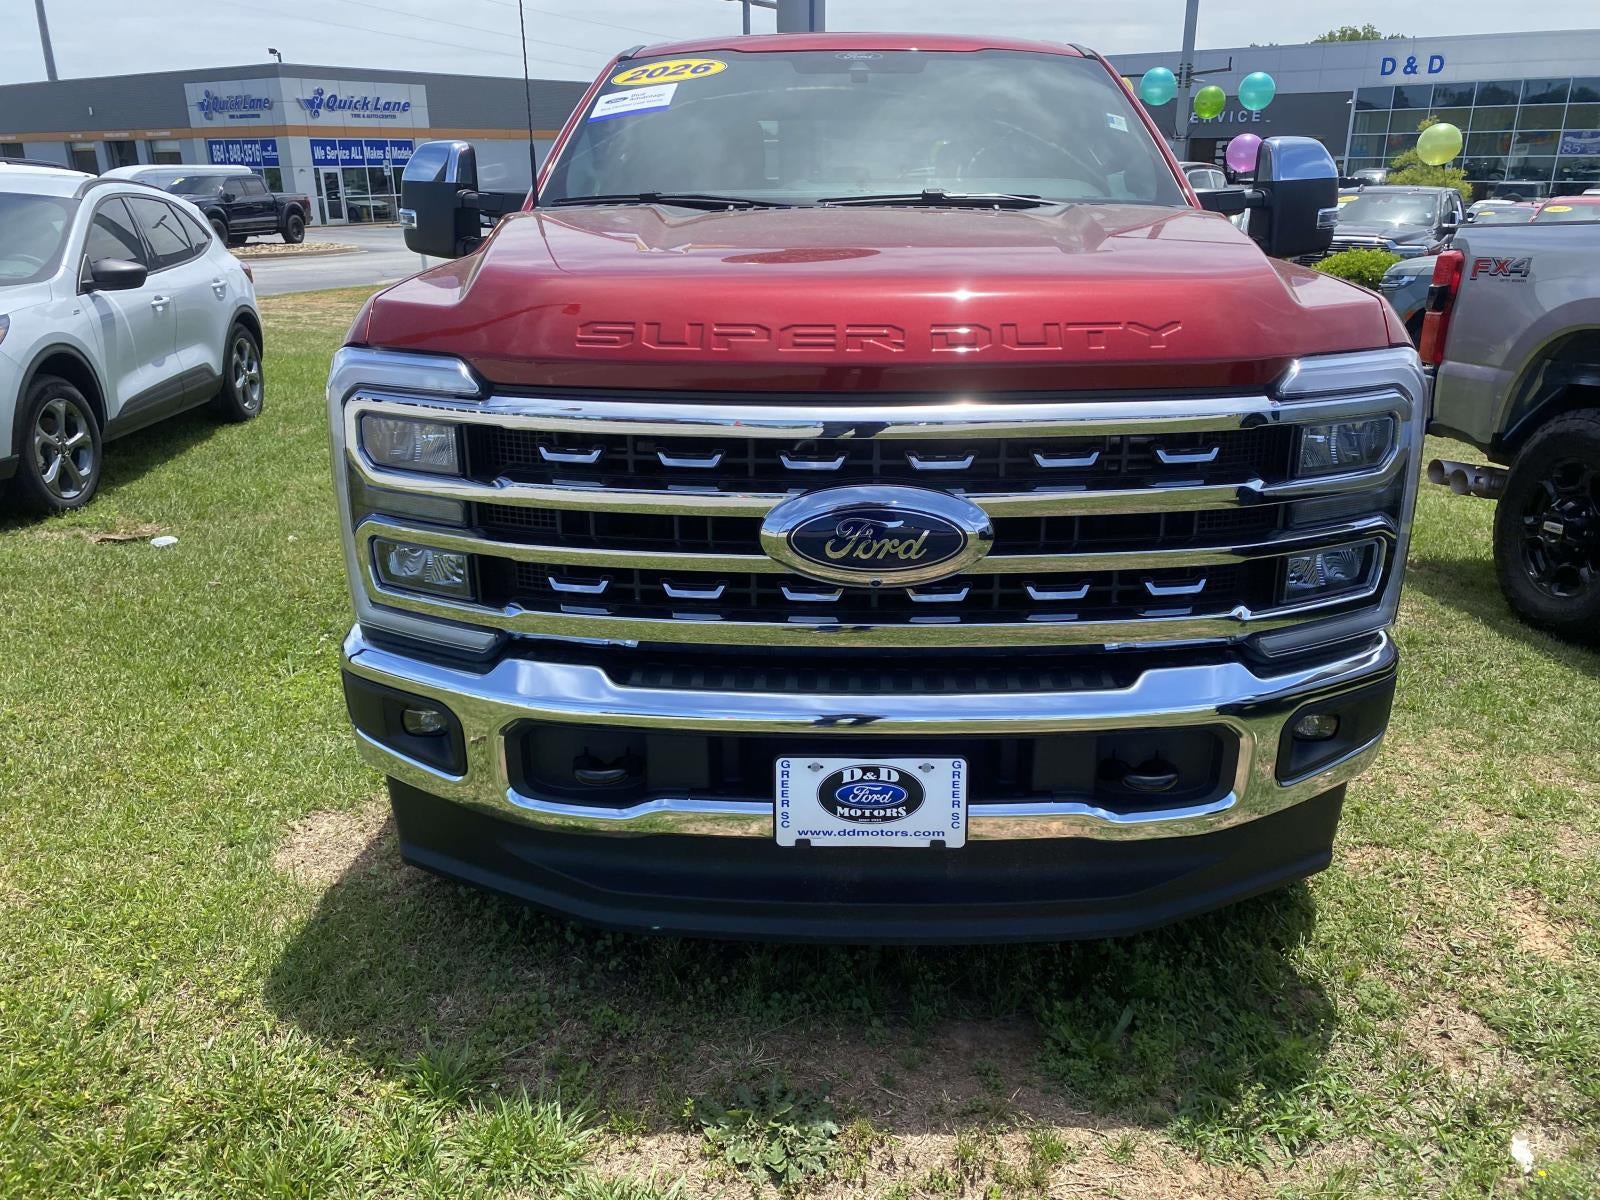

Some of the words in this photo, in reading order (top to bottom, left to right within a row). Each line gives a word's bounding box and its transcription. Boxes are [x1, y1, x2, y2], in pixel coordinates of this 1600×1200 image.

[622, 62, 716, 83] 2026
[242, 95, 273, 111] Lane
[326, 94, 371, 112] Quick
[373, 97, 411, 112] Lane
[313, 146, 326, 160] We
[326, 146, 350, 160] Service
[350, 146, 363, 160] ALL
[364, 146, 384, 160] Makes
[392, 146, 412, 160] Models
[1470, 256, 1534, 280] FX4
[576, 321, 905, 352] SUPER
[930, 321, 1183, 352] DUTY
[825, 517, 931, 560] Ford
[780, 760, 791, 808] GREER
[841, 767, 900, 784] D&D
[951, 760, 962, 809] GREER
[848, 785, 893, 804] Ford
[780, 811, 791, 829] SC
[836, 805, 907, 818] MOTORS
[951, 812, 962, 829] SC
[797, 828, 945, 838] www.ddmotors.com
